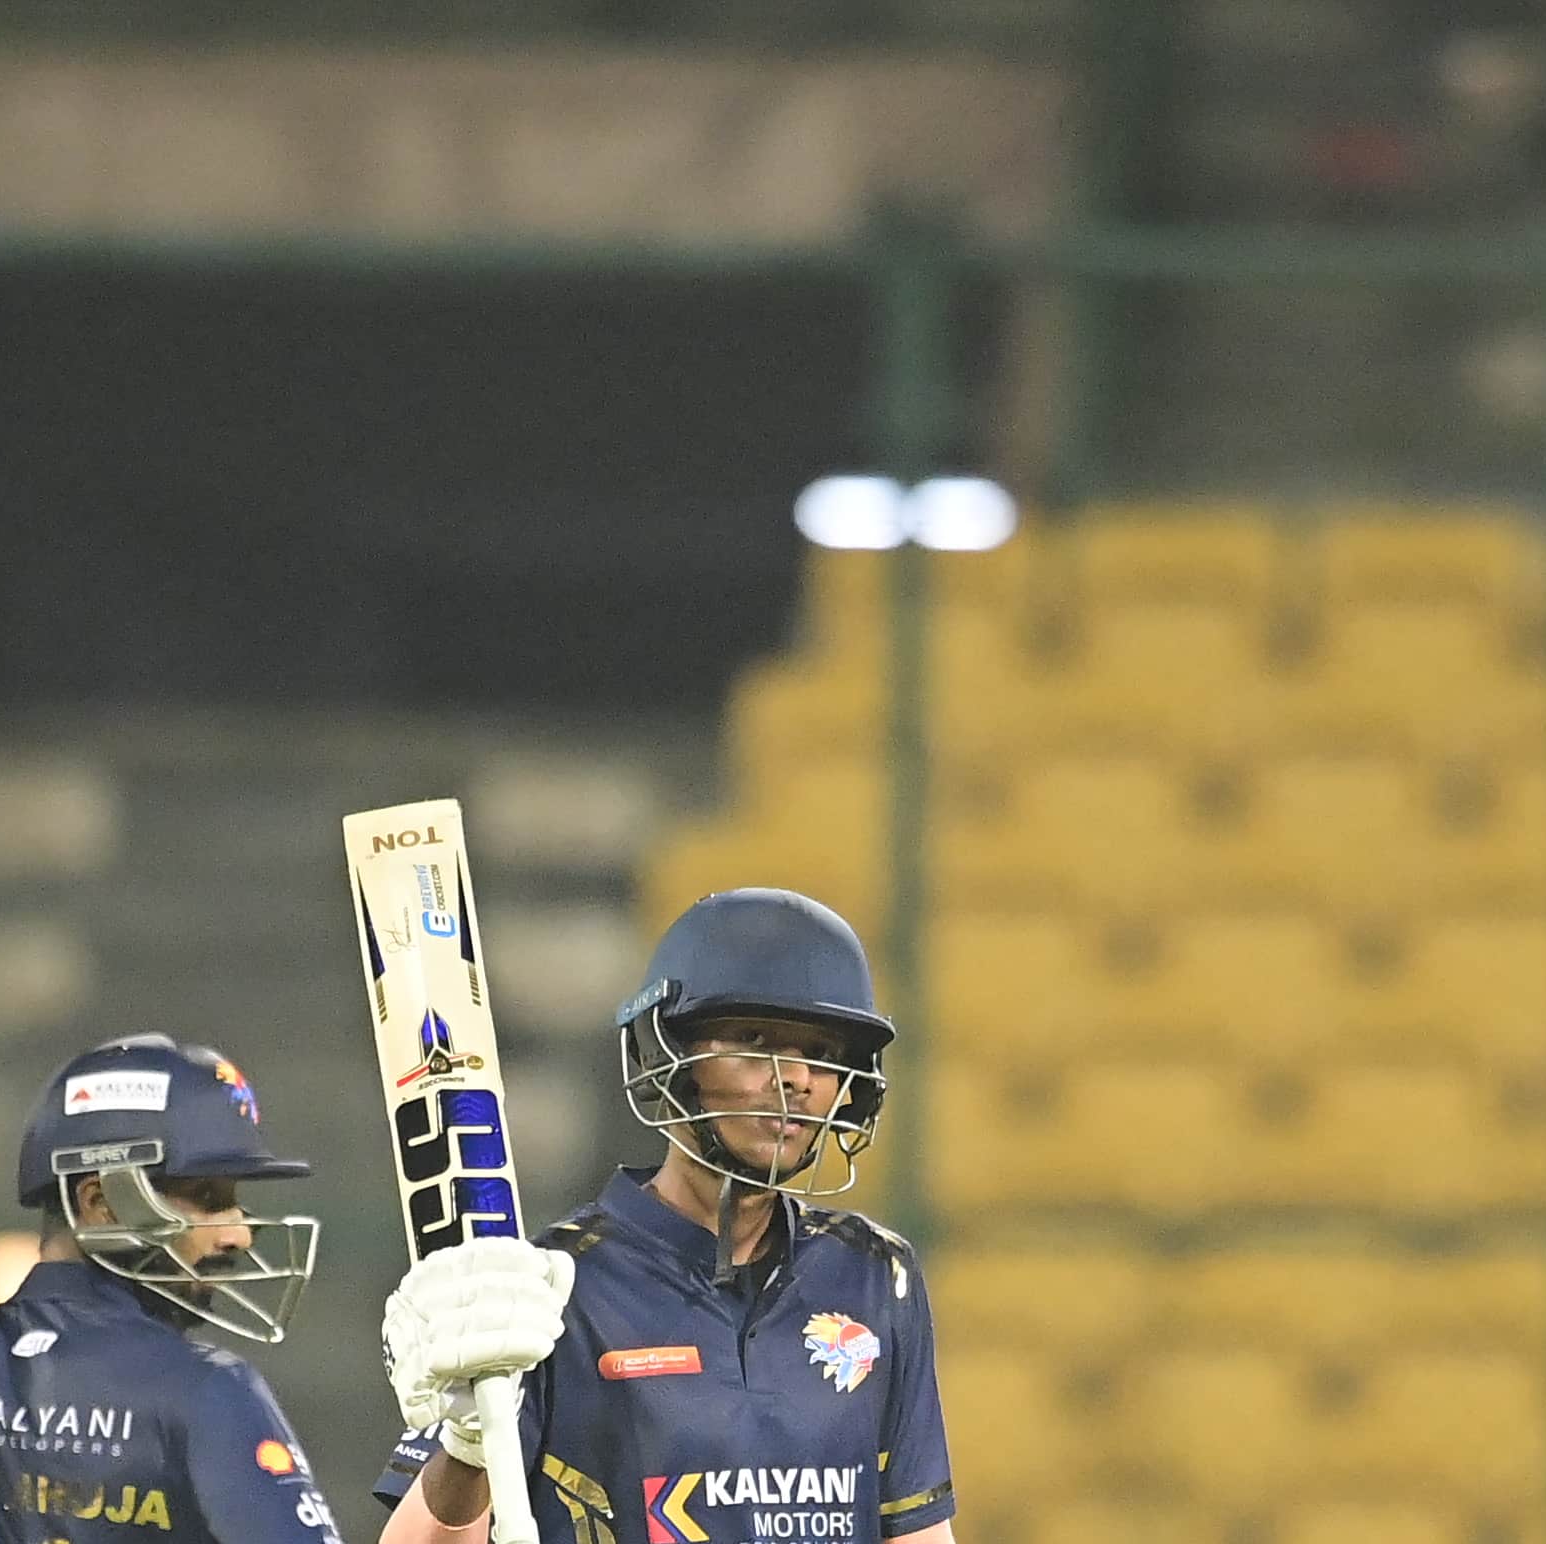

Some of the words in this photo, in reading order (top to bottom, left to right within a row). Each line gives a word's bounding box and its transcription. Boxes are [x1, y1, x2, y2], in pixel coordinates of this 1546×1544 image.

[372, 826, 444, 854] TON
[81, 1146, 130, 1165] SHREY
[705, 1468, 856, 1507] KALYANI
[753, 1511, 854, 1538] MOTORS
